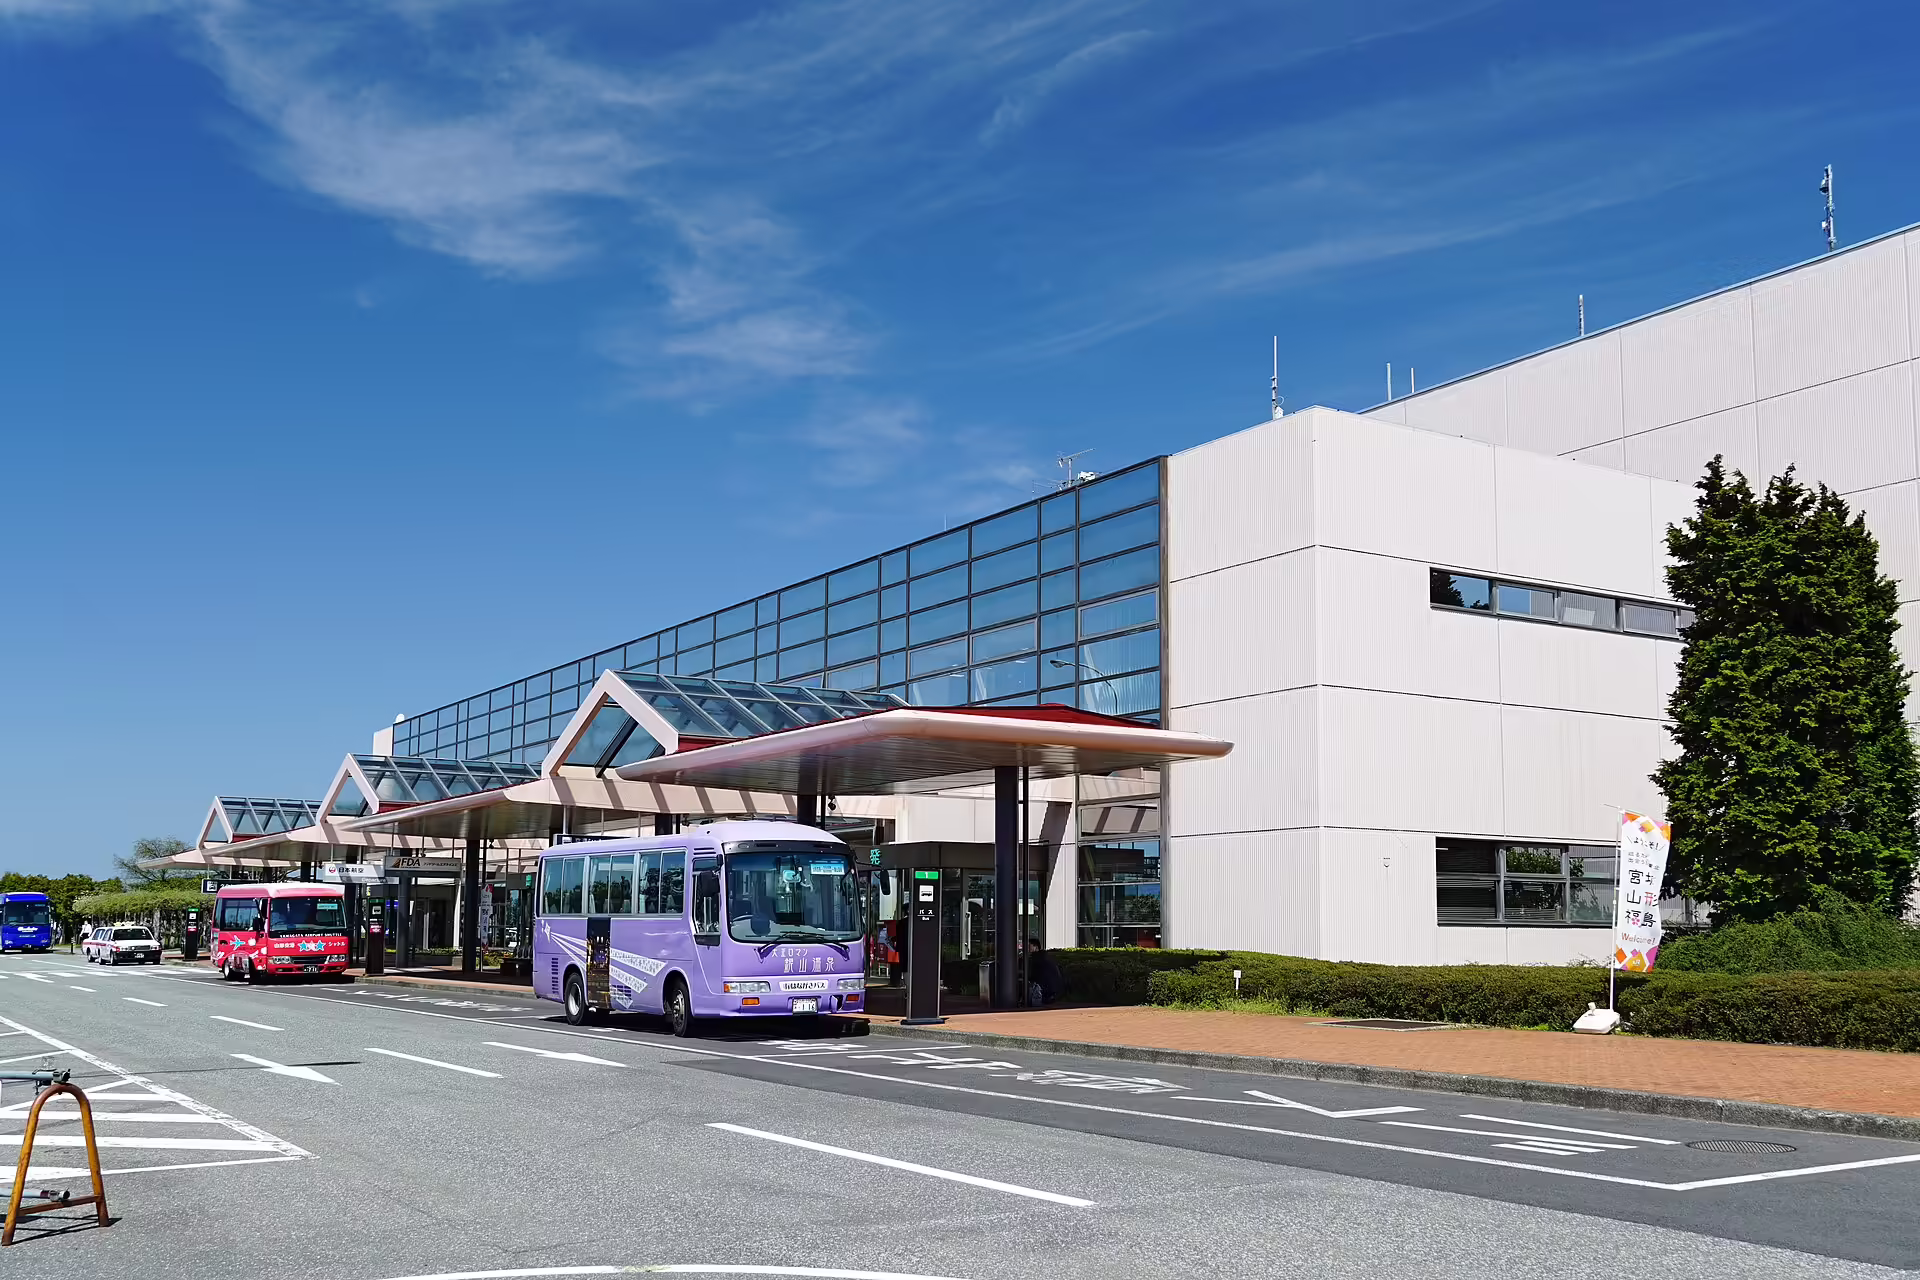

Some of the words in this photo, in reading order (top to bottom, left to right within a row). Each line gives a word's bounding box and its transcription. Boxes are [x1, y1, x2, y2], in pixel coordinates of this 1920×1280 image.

[338, 866, 364, 874] 日本航空
[401, 858, 421, 867] FDA
[1626, 889, 1659, 907] 山形
[1624, 909, 1657, 928] 福島
[783, 956, 835, 973] 銀山温泉
